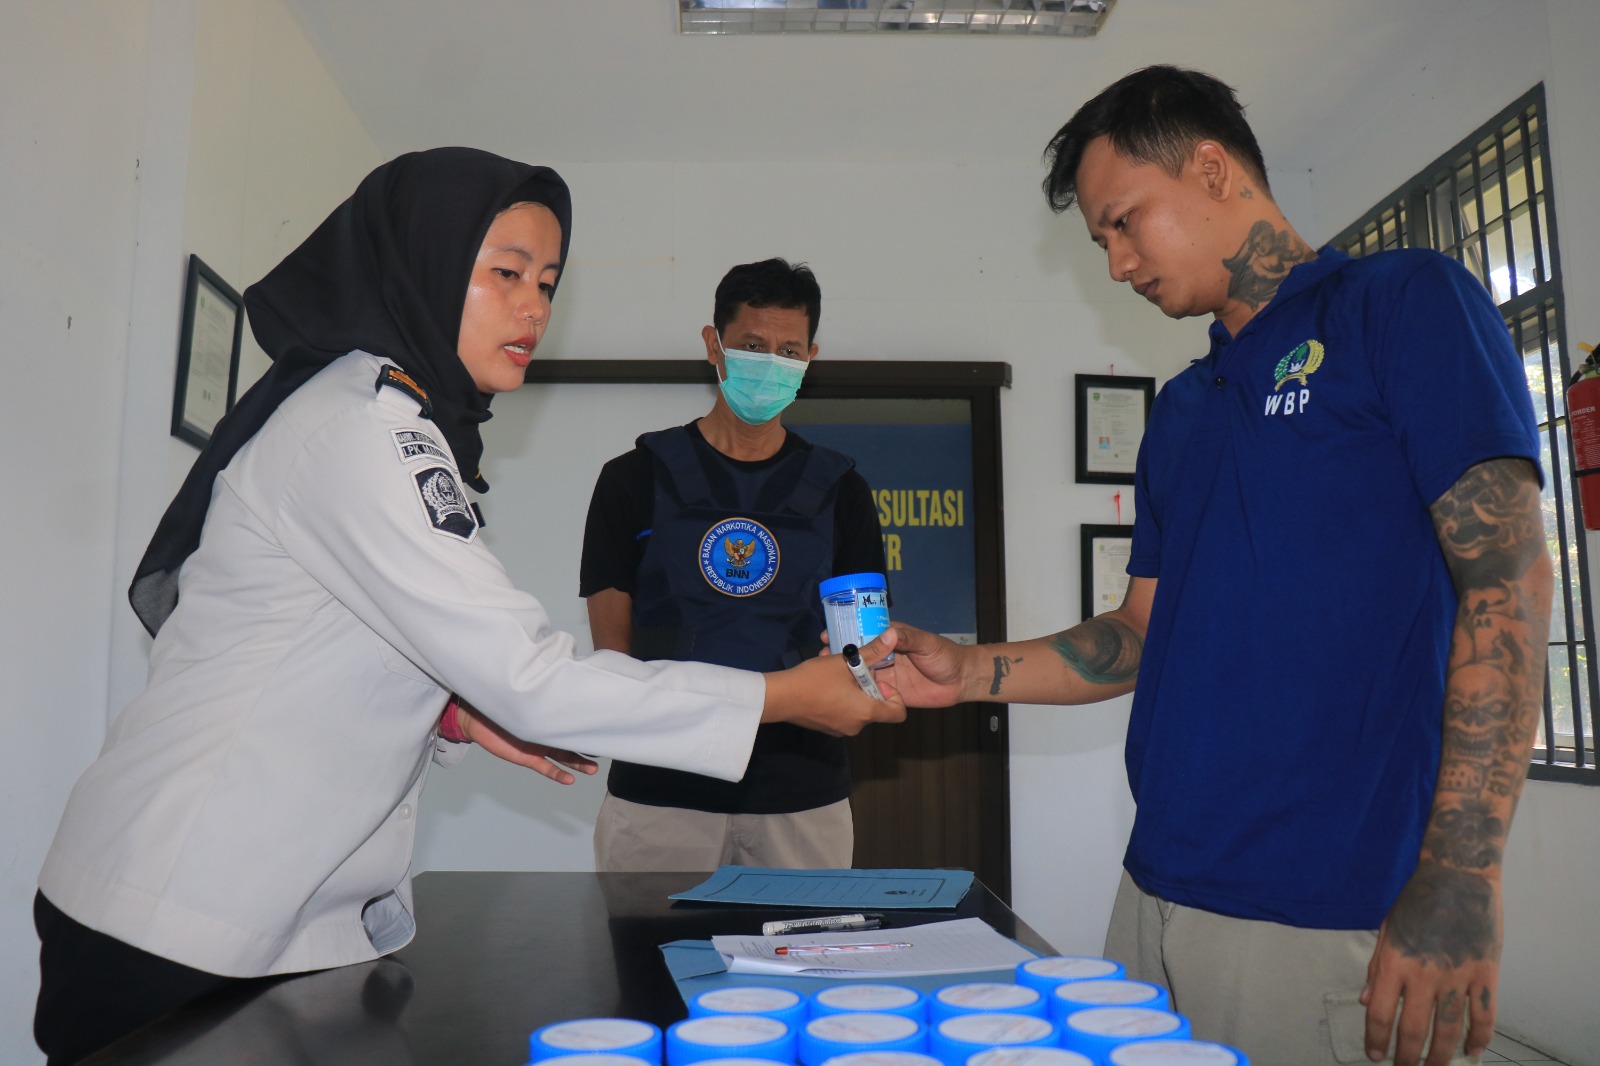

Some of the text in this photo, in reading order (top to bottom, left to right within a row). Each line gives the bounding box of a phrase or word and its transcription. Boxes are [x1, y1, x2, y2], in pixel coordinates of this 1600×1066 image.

[1264, 388, 1310, 416] WBP
[702, 521, 776, 564] BADAN NARKOTIKA NASIONAL
[882, 534, 902, 571] R
[705, 565, 773, 594] REPUBLIK INDONESIA
[725, 568, 750, 579] BNN
